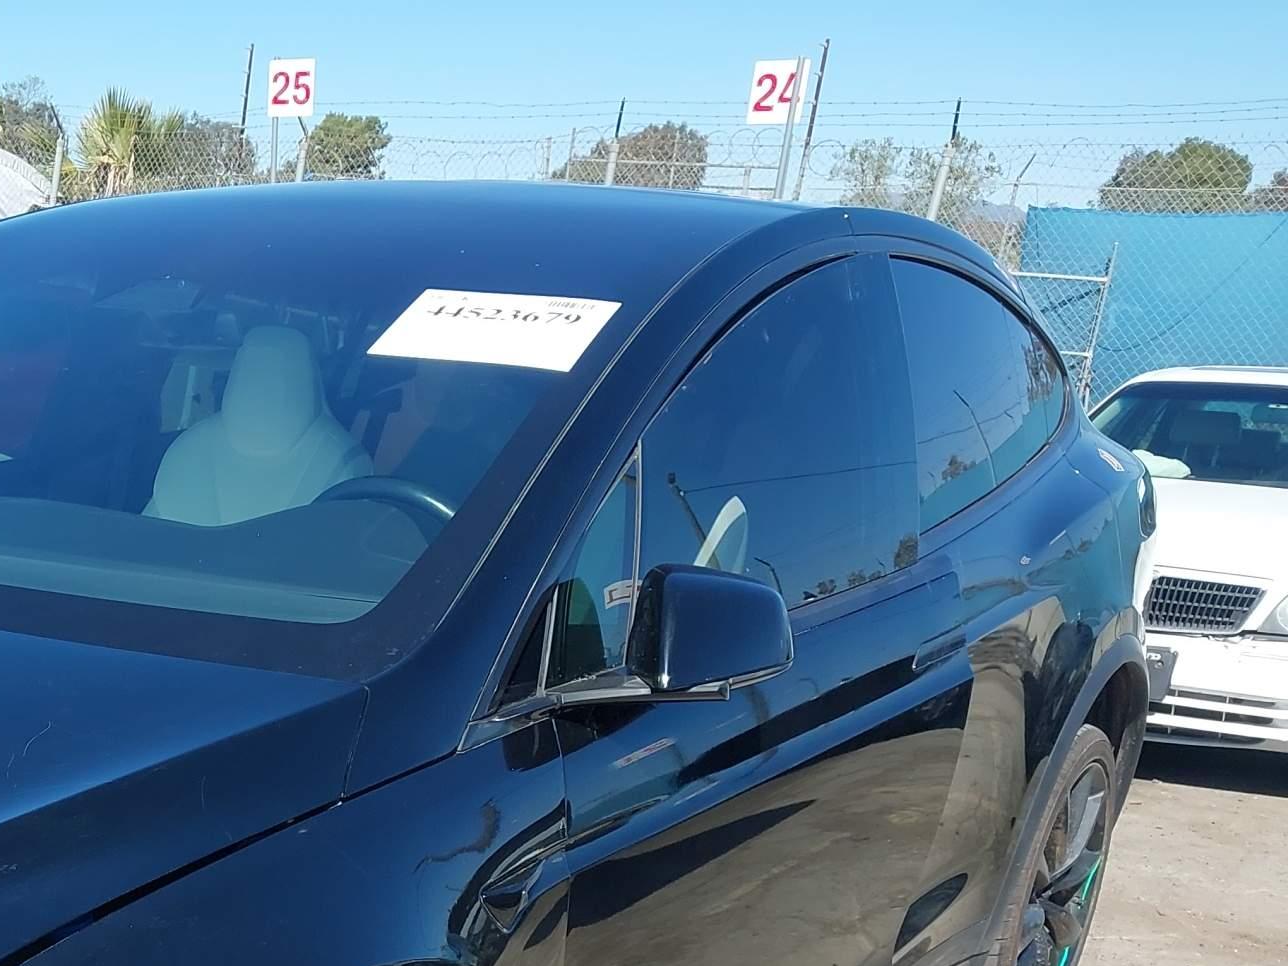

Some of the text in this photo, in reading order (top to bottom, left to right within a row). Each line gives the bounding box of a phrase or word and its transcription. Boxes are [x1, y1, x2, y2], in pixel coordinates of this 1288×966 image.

[272, 71, 310, 105] 25
[752, 72, 800, 112] 24
[426, 304, 582, 325] 44523679
